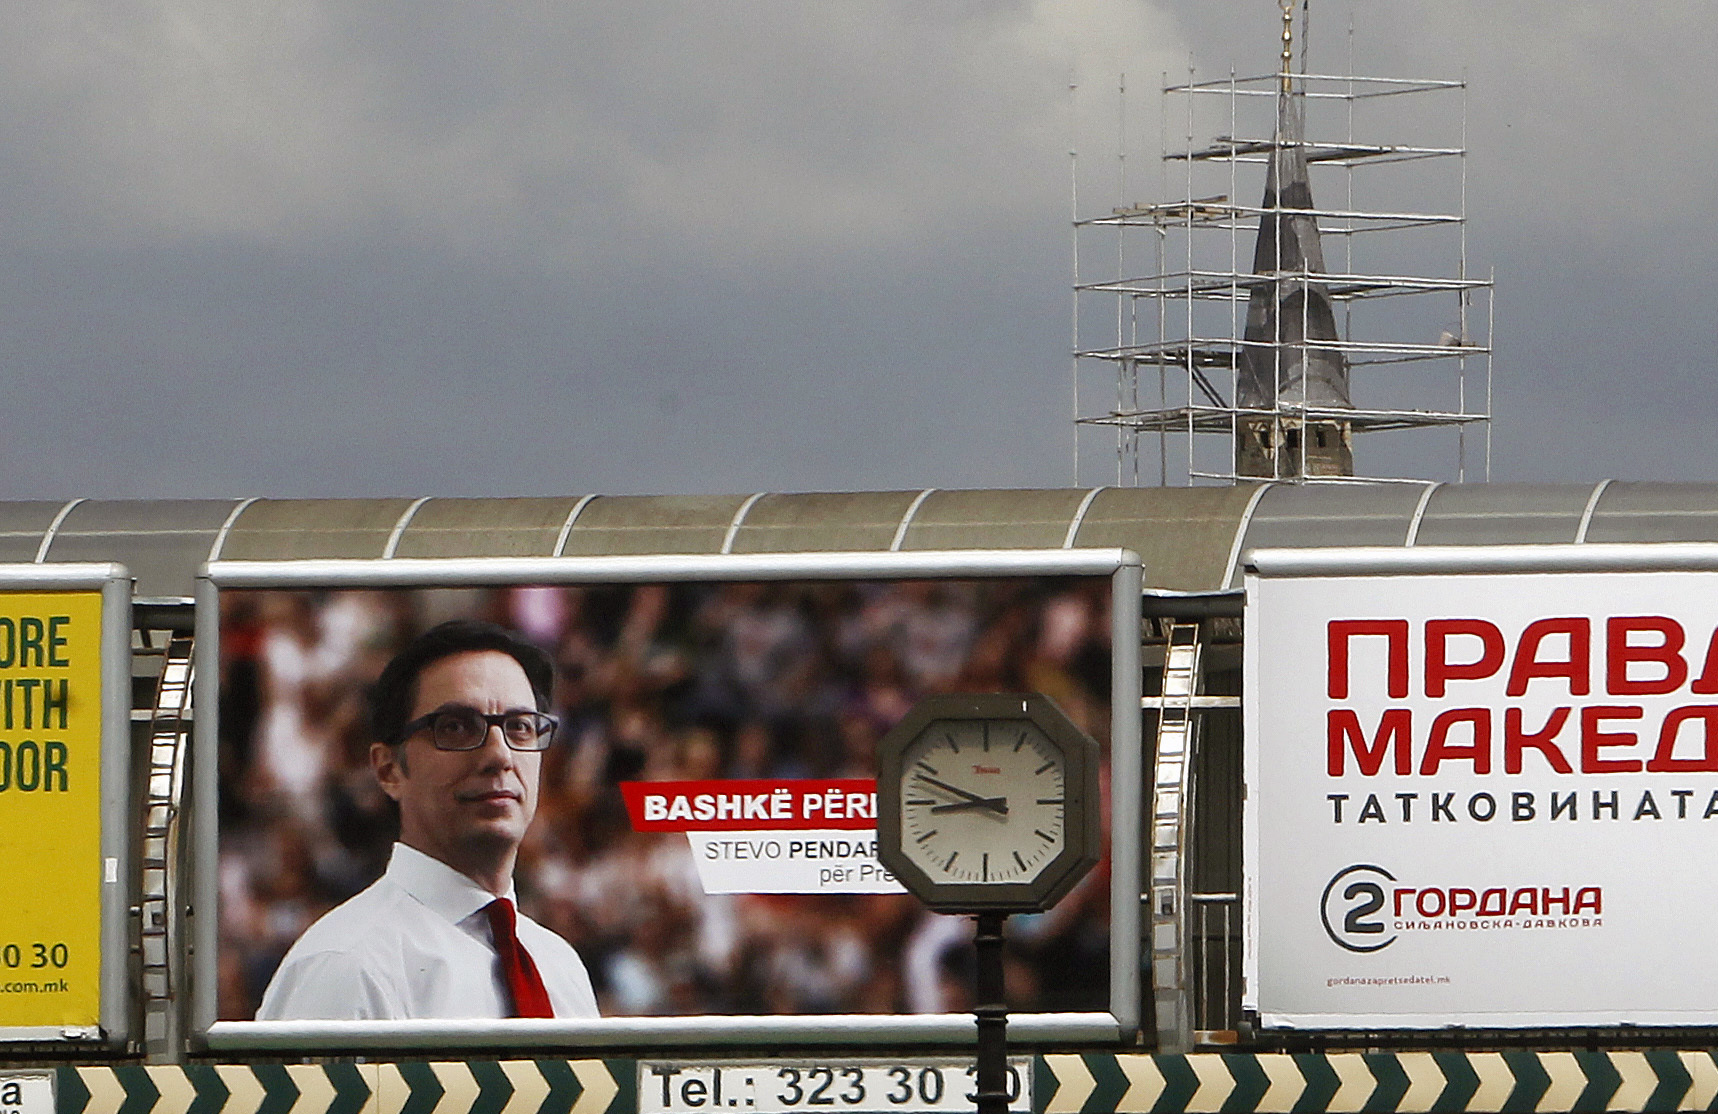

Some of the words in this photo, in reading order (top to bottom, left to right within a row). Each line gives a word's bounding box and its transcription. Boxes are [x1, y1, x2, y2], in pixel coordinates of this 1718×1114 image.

[0, 679, 68, 730] ITH
[644, 788, 793, 821] BASHKË
[706, 841, 781, 859] STEVO
[820, 866, 852, 886] për
[1344, 882, 1385, 933] 2
[1394, 886, 1602, 918] ГОРДАНА
[1394, 918, 1603, 930] СИЉАНОВСКА-ДАВКОВА
[0, 943, 21, 969] 0
[30, 943, 68, 969] 30
[652, 1068, 755, 1107] Tel.:
[777, 1067, 866, 1105] 323
[887, 1067, 944, 1104] 30
